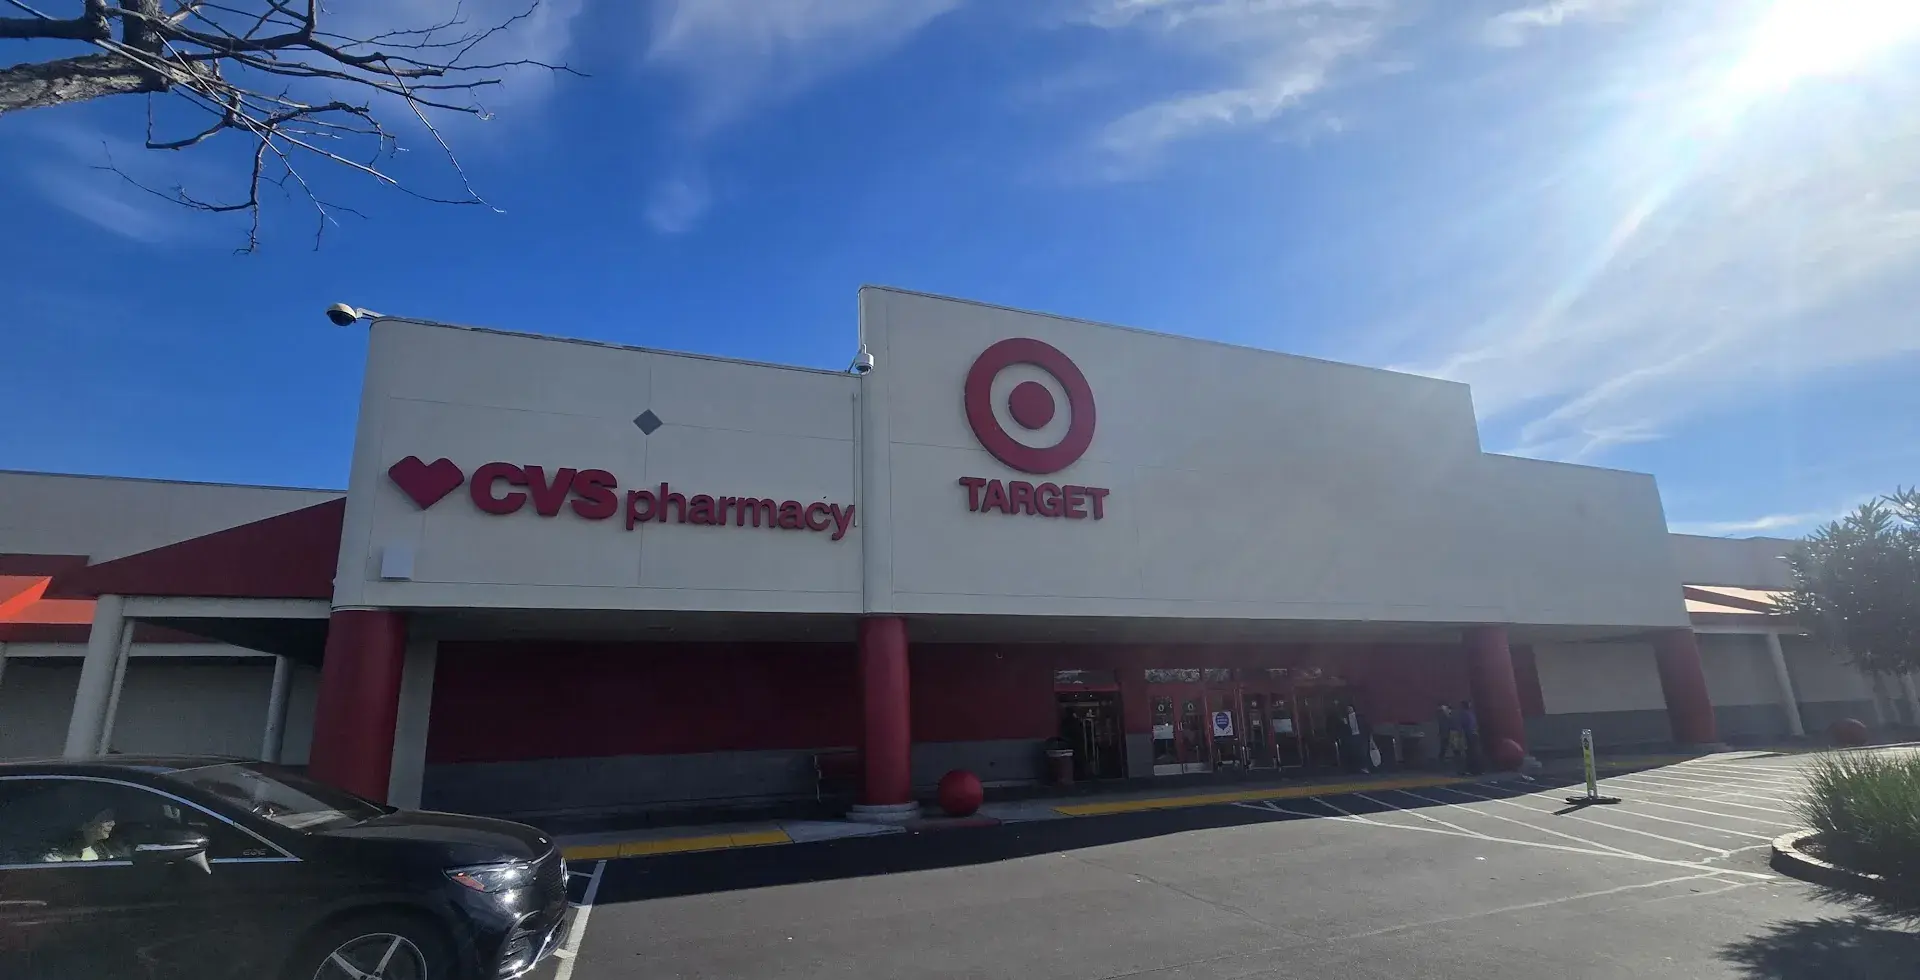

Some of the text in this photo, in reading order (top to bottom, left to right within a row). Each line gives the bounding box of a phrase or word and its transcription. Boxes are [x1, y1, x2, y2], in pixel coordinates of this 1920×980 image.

[470, 462, 855, 541] CVS pharmacy
[959, 477, 1110, 520] TARGET
